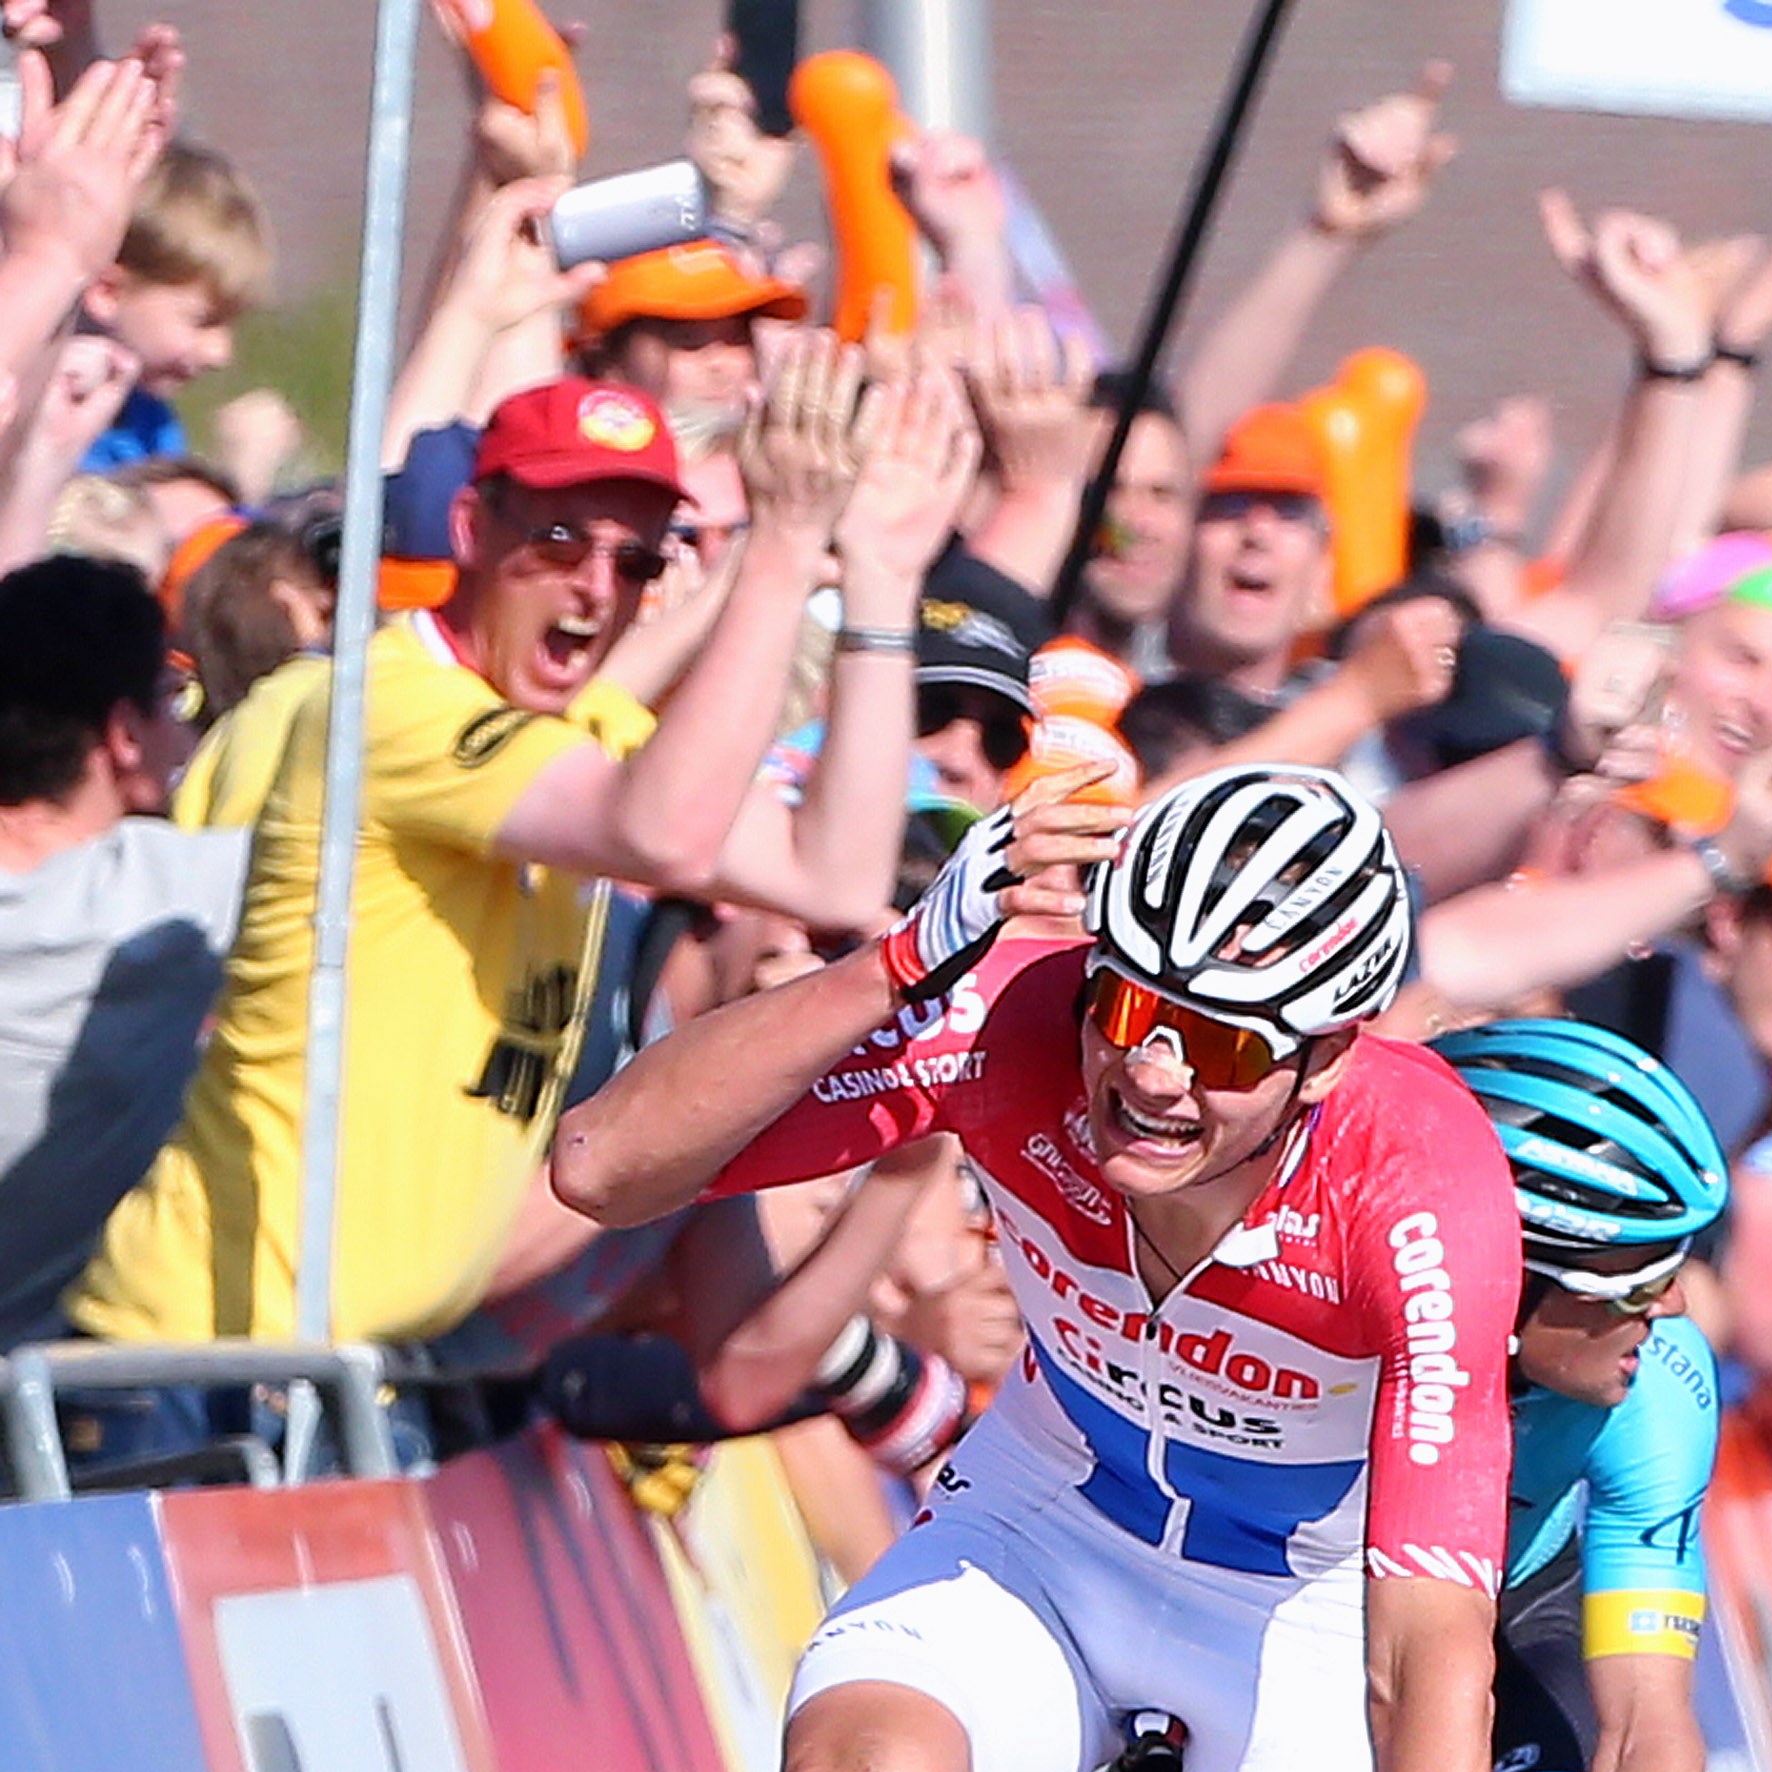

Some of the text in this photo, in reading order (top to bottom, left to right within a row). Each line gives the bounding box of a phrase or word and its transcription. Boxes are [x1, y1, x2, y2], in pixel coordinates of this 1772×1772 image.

[812, 1066, 899, 1103] CASINO
[997, 1207, 1320, 1399] corendon
[1388, 1211, 1470, 1444] corendon
[1650, 1332, 1711, 1410] stana
